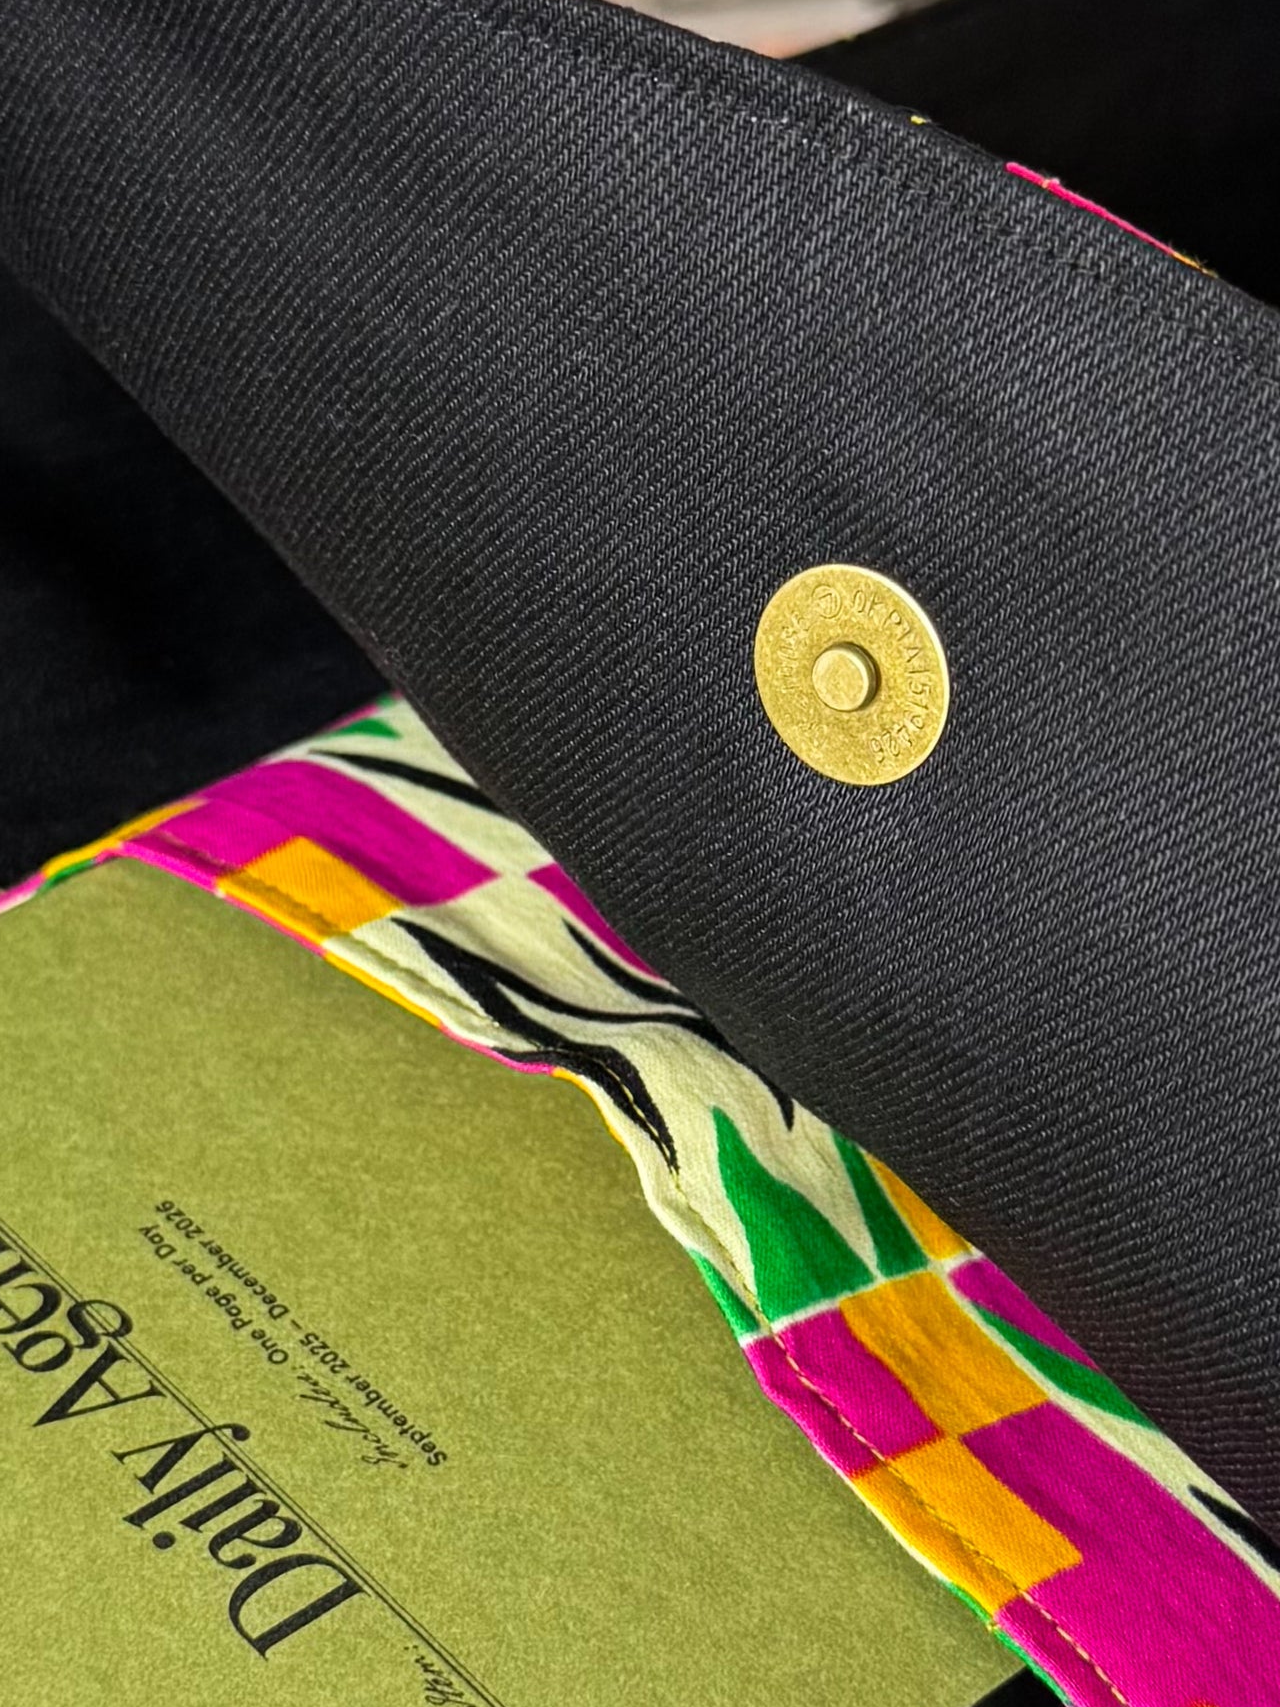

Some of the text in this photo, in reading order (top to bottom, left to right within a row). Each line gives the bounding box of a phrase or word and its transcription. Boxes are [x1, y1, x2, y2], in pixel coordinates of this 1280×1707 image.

[155, 1200, 205, 1239] 2026
[138, 1224, 177, 1260] Day
[172, 1258, 214, 1286] per
[199, 1240, 290, 1320] December
[205, 1285, 253, 1331] Page
[251, 1328, 289, 1365] One
[299, 1332, 351, 1374] 2025
[345, 1374, 448, 1467] September
[111, 1421, 371, 1662] Daily
